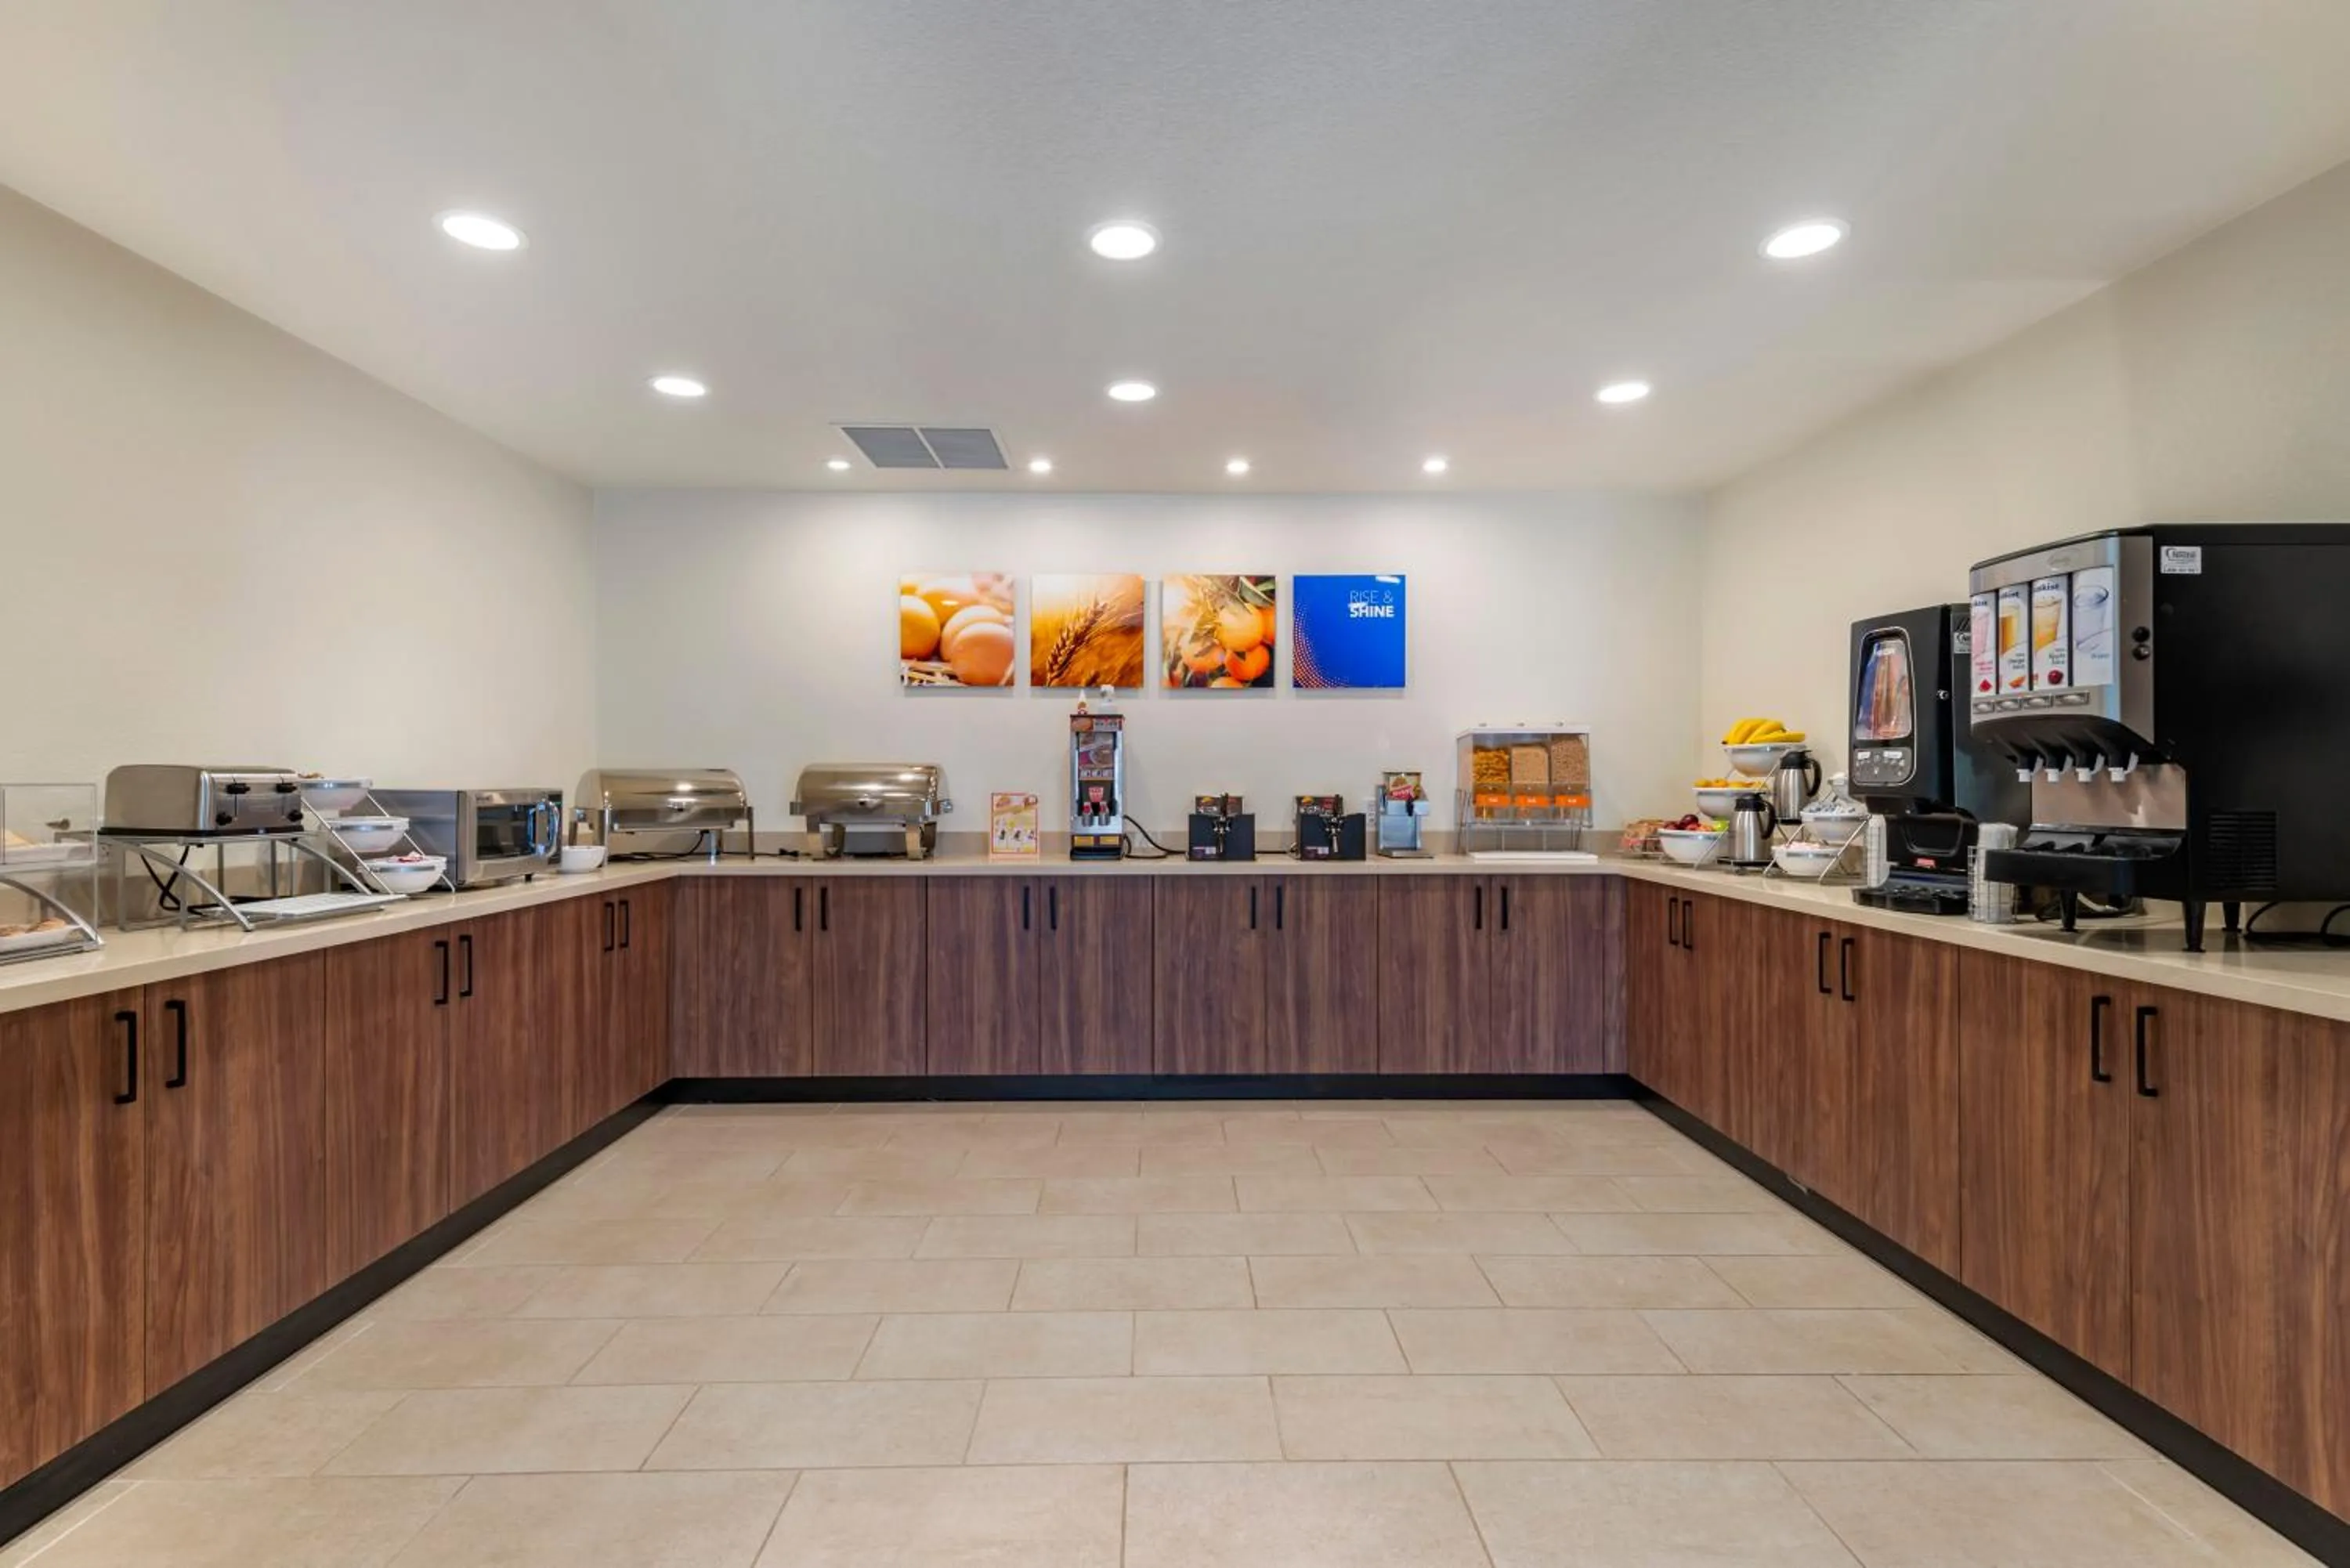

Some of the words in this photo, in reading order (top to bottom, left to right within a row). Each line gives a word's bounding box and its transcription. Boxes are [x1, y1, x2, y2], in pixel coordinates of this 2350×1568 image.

[1350, 590, 1379, 603] RISE
[1383, 589, 1394, 604] &
[1350, 605, 1394, 618] SHINE
